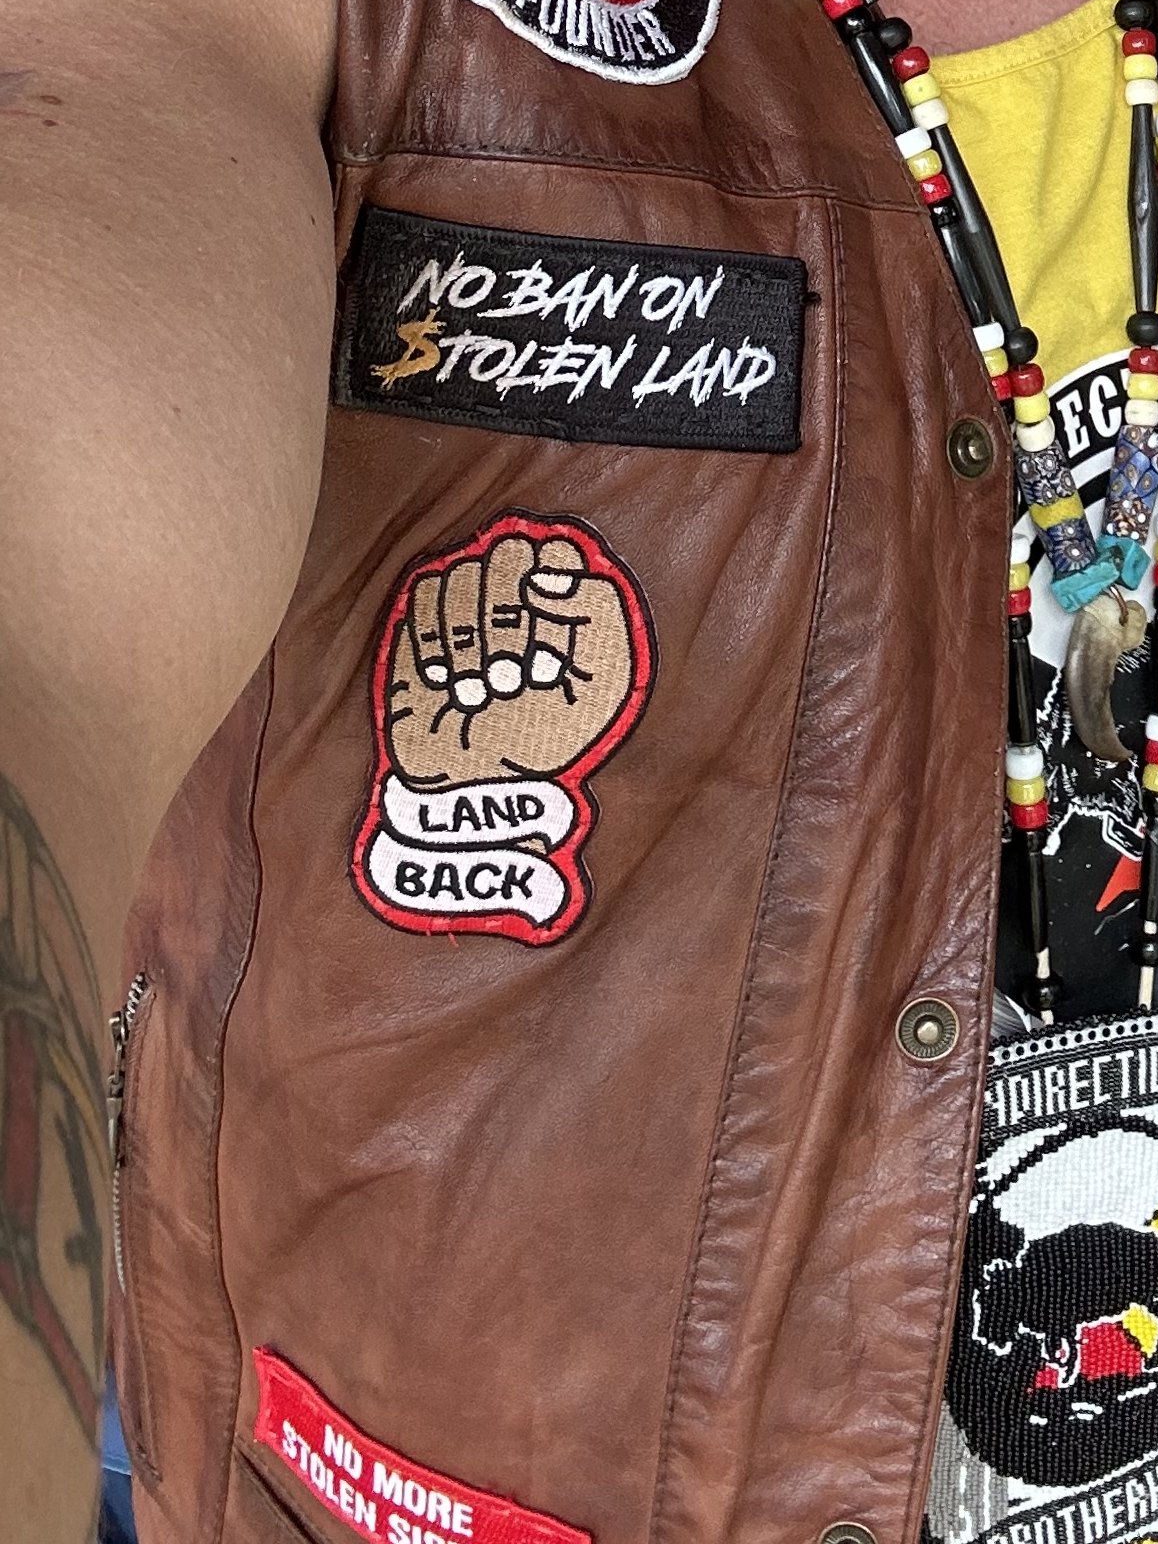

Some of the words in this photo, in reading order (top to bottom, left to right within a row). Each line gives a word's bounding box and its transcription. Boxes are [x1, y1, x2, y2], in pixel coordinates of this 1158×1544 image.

[397, 250, 498, 315] NO
[476, 259, 638, 332] BAN
[639, 264, 726, 334] ON
[632, 335, 778, 408] LAND
[419, 793, 546, 834] LAND
[395, 861, 535, 900] BACK
[282, 1419, 377, 1533] STOLEN
[323, 1423, 363, 1480] NO
[373, 1461, 474, 1538] MORE
